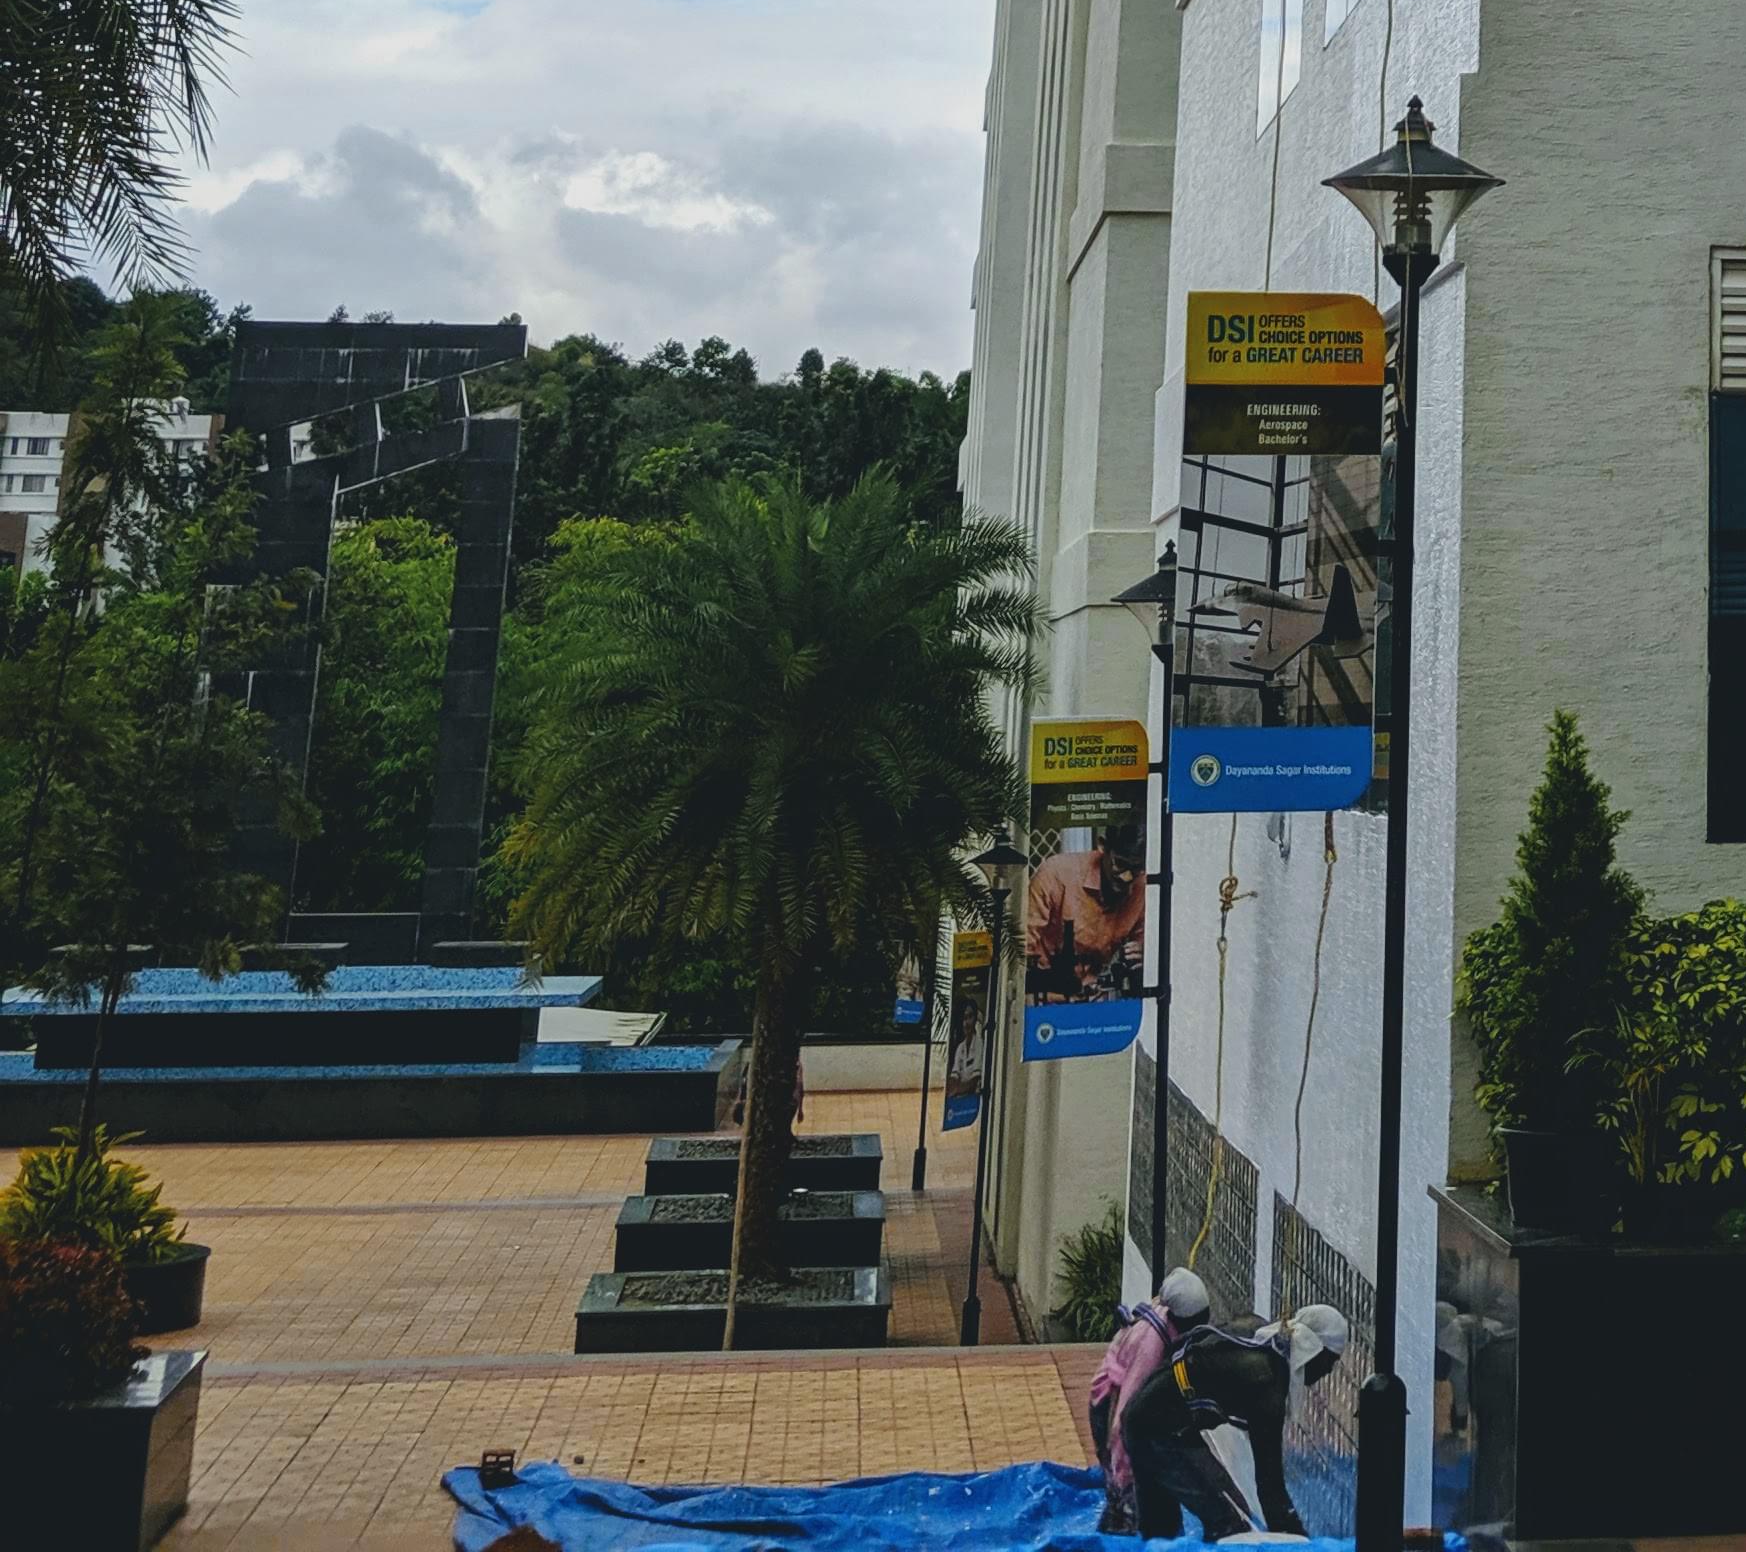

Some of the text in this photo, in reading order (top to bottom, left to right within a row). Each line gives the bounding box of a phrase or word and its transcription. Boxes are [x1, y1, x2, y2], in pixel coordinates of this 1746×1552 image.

[1258, 314, 1306, 328] OFFERS
[1207, 314, 1255, 344] DSI
[1258, 330, 1364, 345] CHOICE OPTIONS
[1208, 347, 1364, 364] for a GREAT CAREER
[1246, 403, 1322, 416] ENGINEERING:
[1258, 419, 1309, 432] Aerospace
[1044, 736, 1073, 756] DSI
[1104, 744, 1138, 755] OPTIONS
[1225, 764, 1352, 778] Dayananda Sagar Institutions
